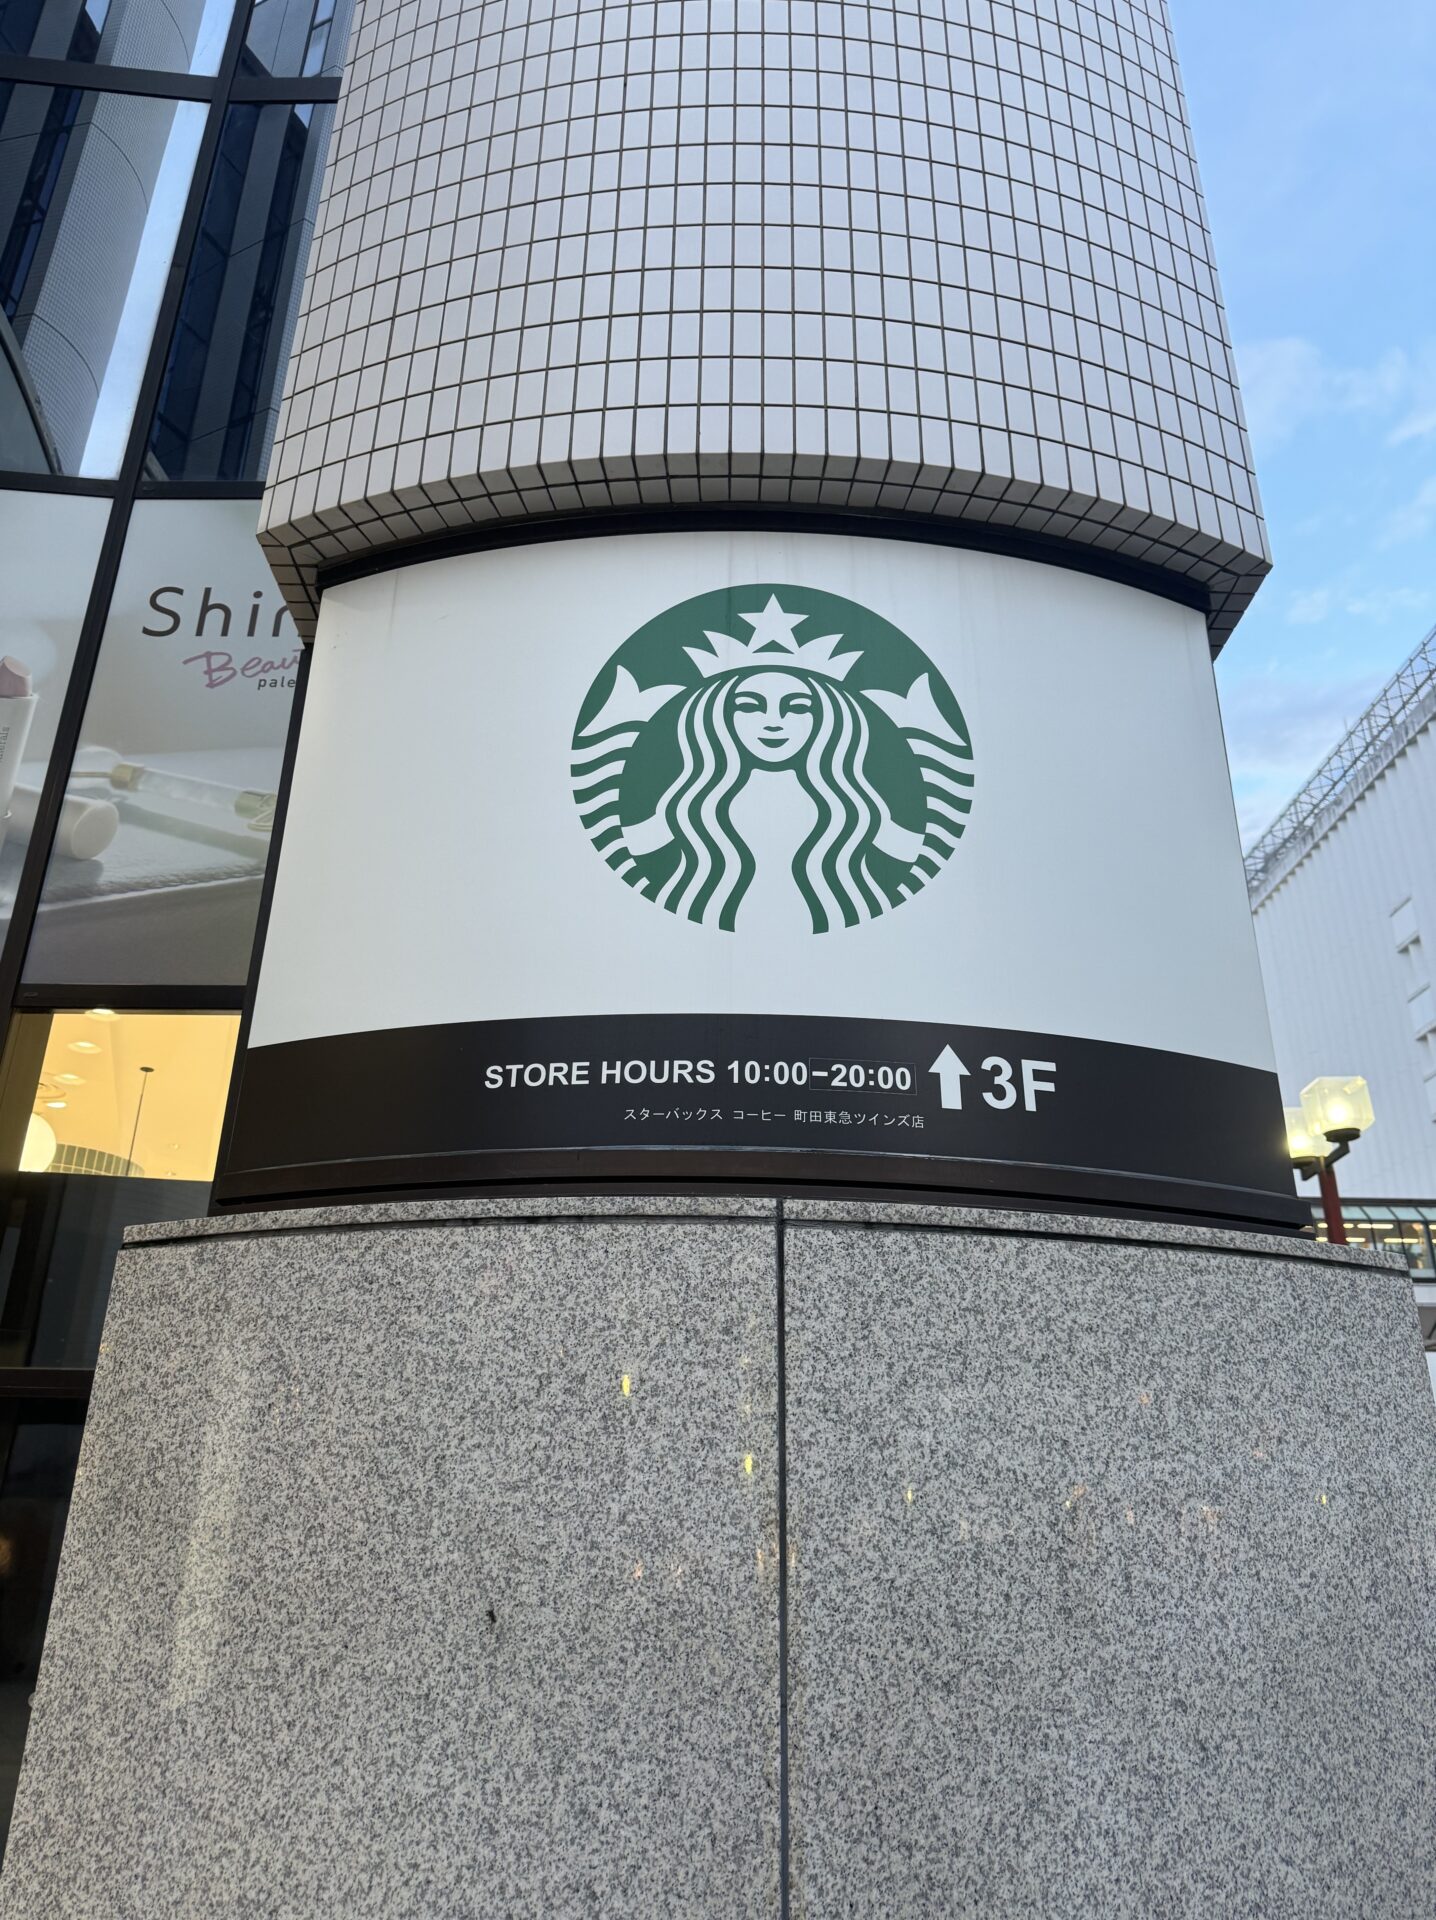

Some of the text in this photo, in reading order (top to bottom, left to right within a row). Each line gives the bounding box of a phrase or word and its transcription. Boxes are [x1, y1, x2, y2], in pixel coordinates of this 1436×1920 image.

[182, 649, 301, 689] Beau
[484, 1062, 590, 1089] STORE
[601, 1059, 716, 1084] HOURS
[980, 1056, 1057, 1112] 3F
[623, 1107, 925, 1129] スターバックス コーヒー 町田東急ツインズ店
